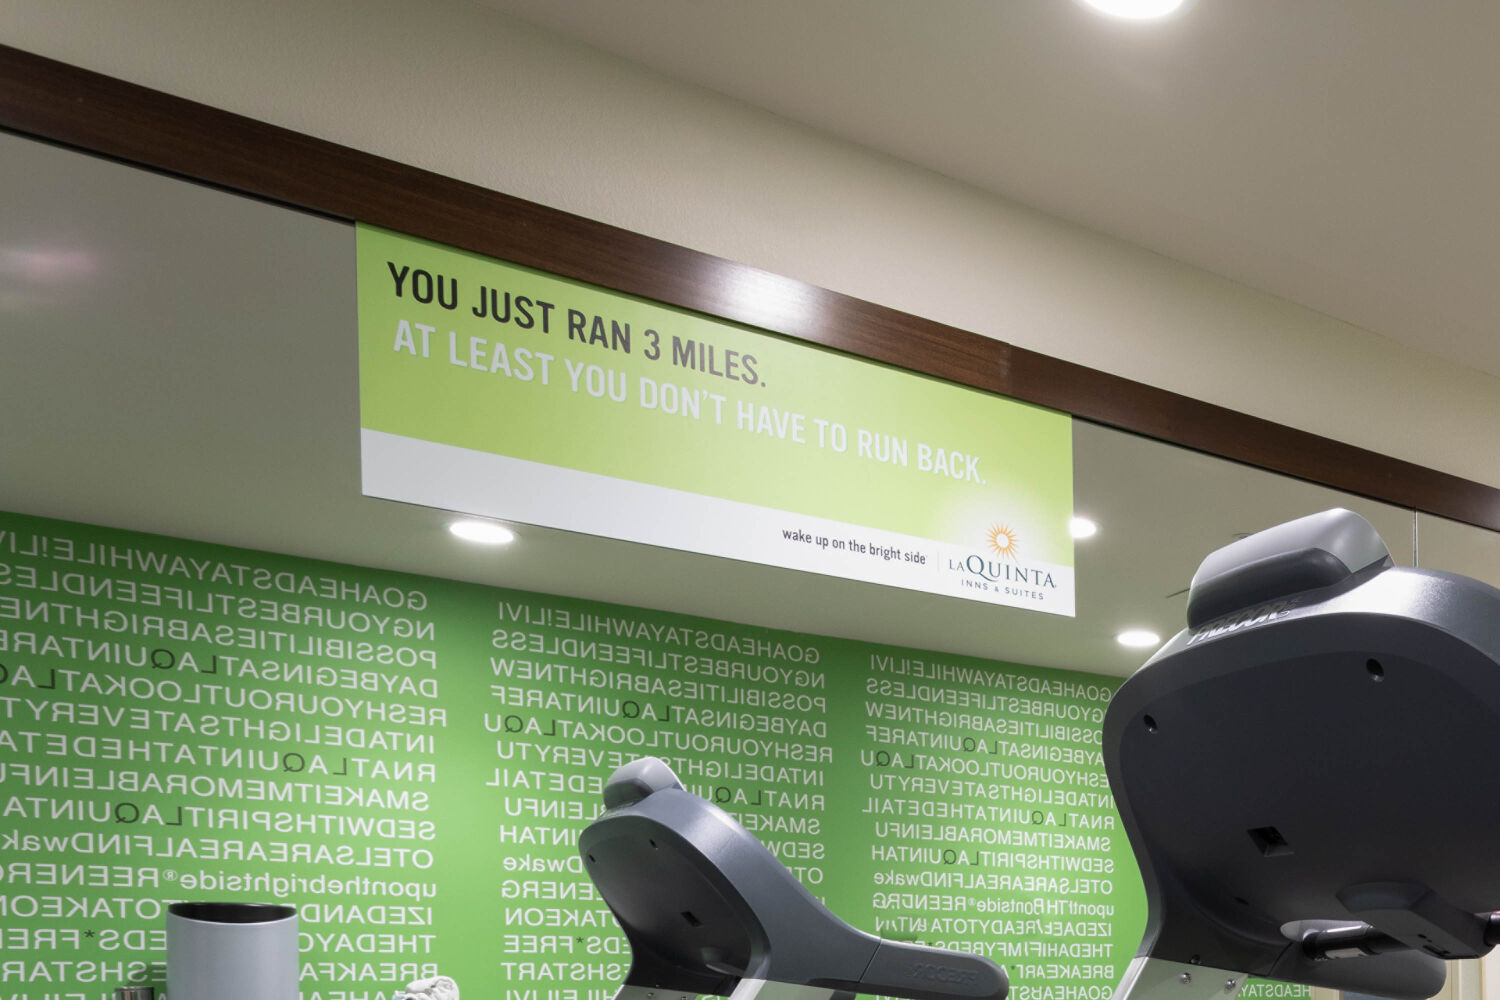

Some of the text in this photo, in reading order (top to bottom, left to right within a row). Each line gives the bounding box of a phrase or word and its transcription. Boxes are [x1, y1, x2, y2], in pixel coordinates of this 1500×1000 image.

[388, 261, 767, 388] YOU JUST RAN 3 MILES.
[393, 319, 986, 485] AT LEAST YOU DON'T HAVE TO RUN BACK.
[783, 528, 926, 565] wake up on the bright side
[961, 579, 988, 590] INNS
[1005, 587, 1044, 600] SUITES
